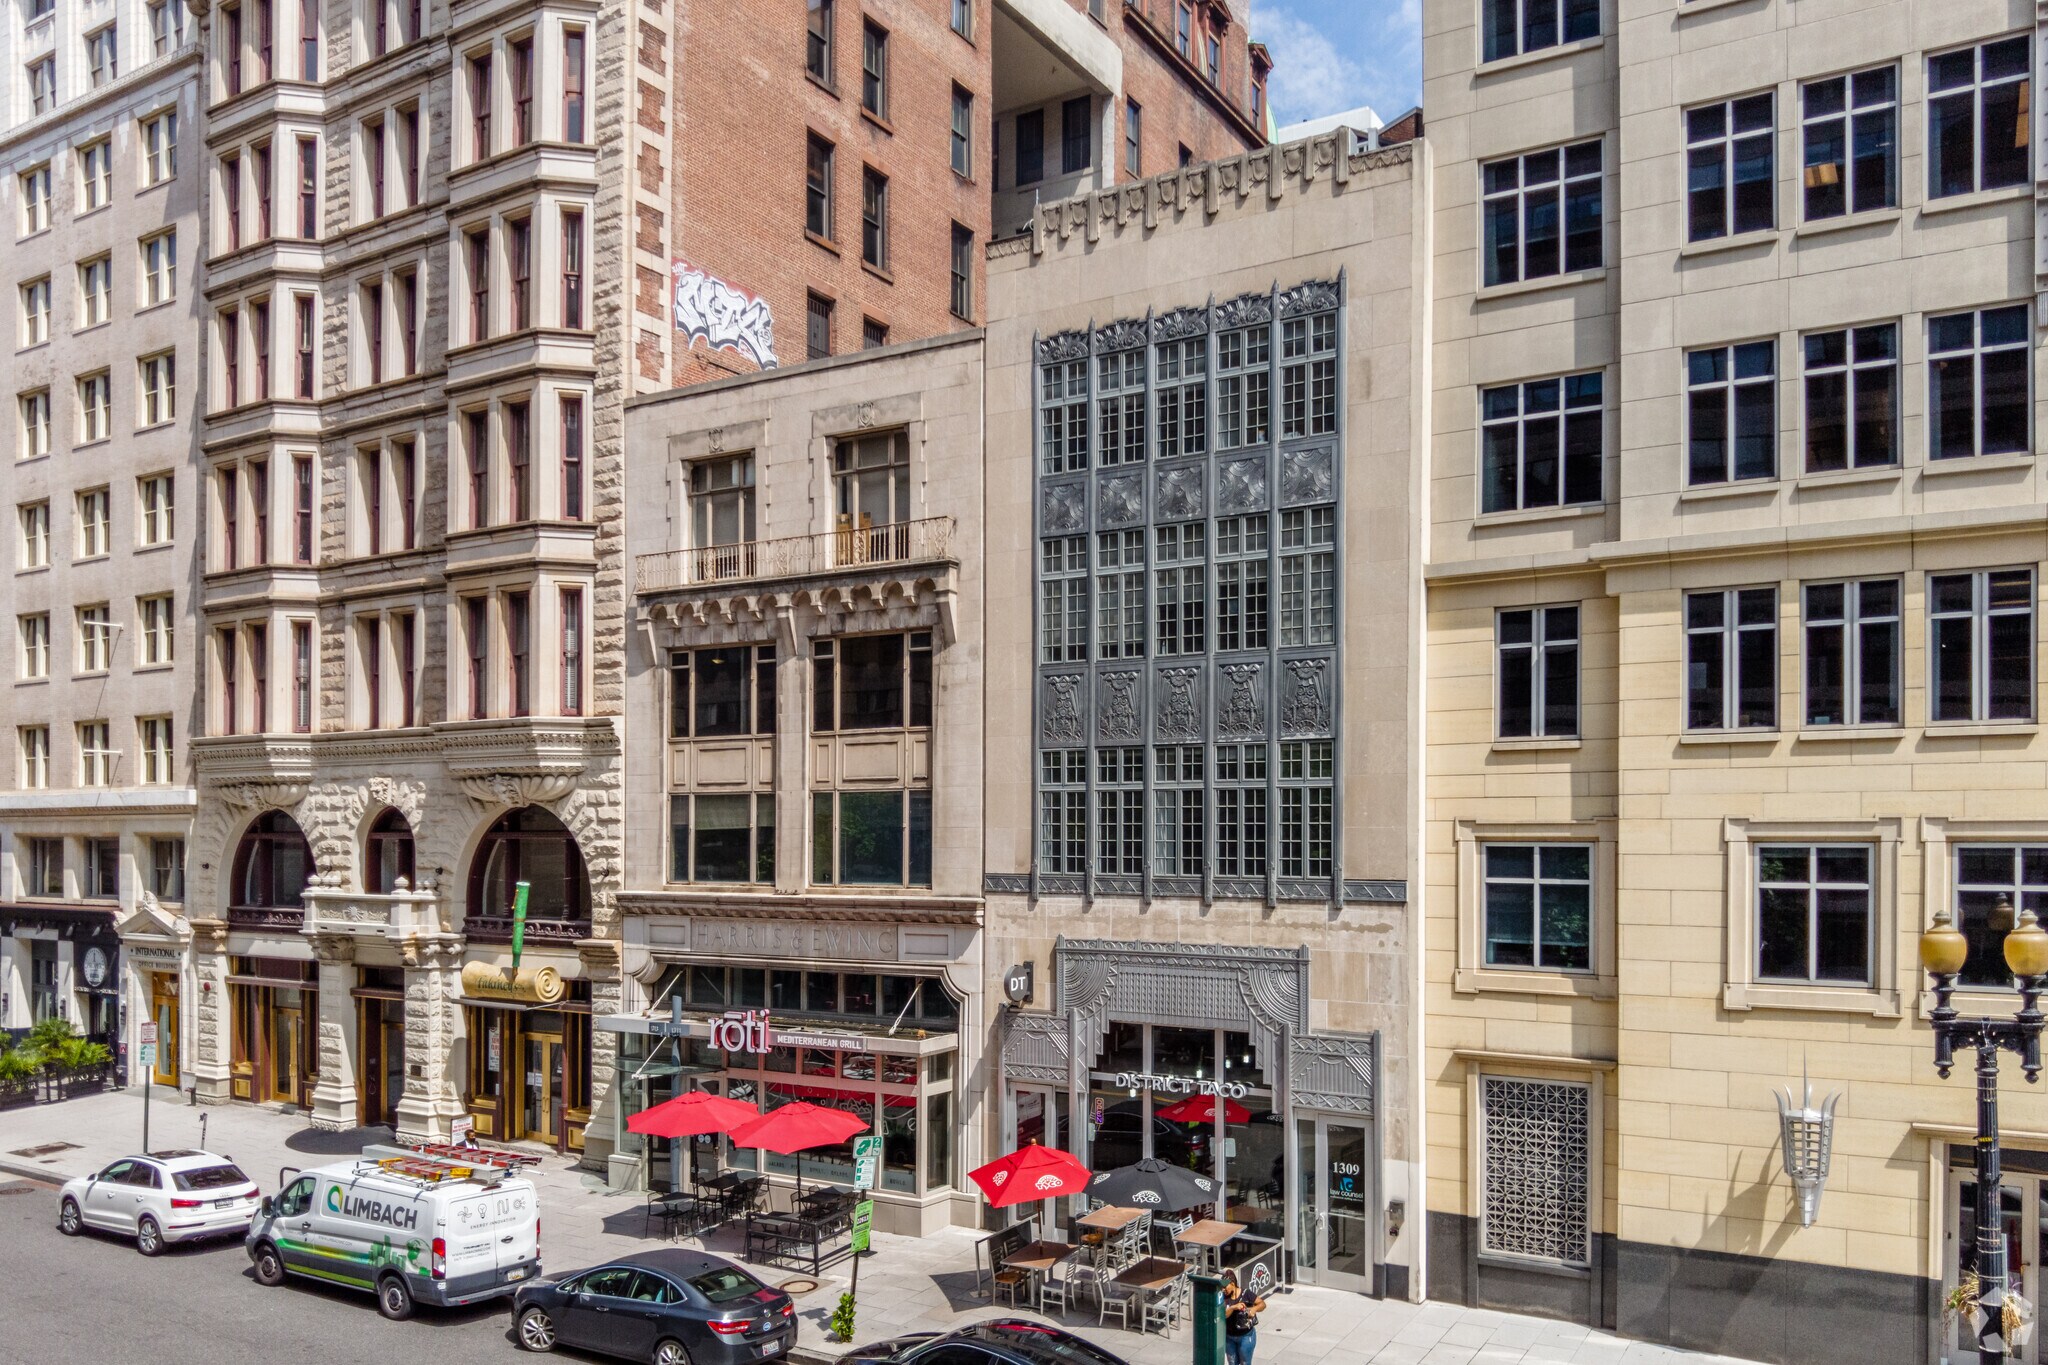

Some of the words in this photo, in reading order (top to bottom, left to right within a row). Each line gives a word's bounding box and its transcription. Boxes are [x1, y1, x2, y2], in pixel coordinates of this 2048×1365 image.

[135, 947, 176, 958] INTERNATIONAL
[1010, 976, 1026, 992] DT
[777, 1035, 838, 1047] MEDITERRANEAN
[840, 1039, 862, 1049] GRILL
[1115, 1073, 1192, 1094] DISTRICT
[1196, 1080, 1247, 1099] TACO
[1333, 1162, 1360, 1176] 1309
[343, 1195, 418, 1230] LIMBACH
